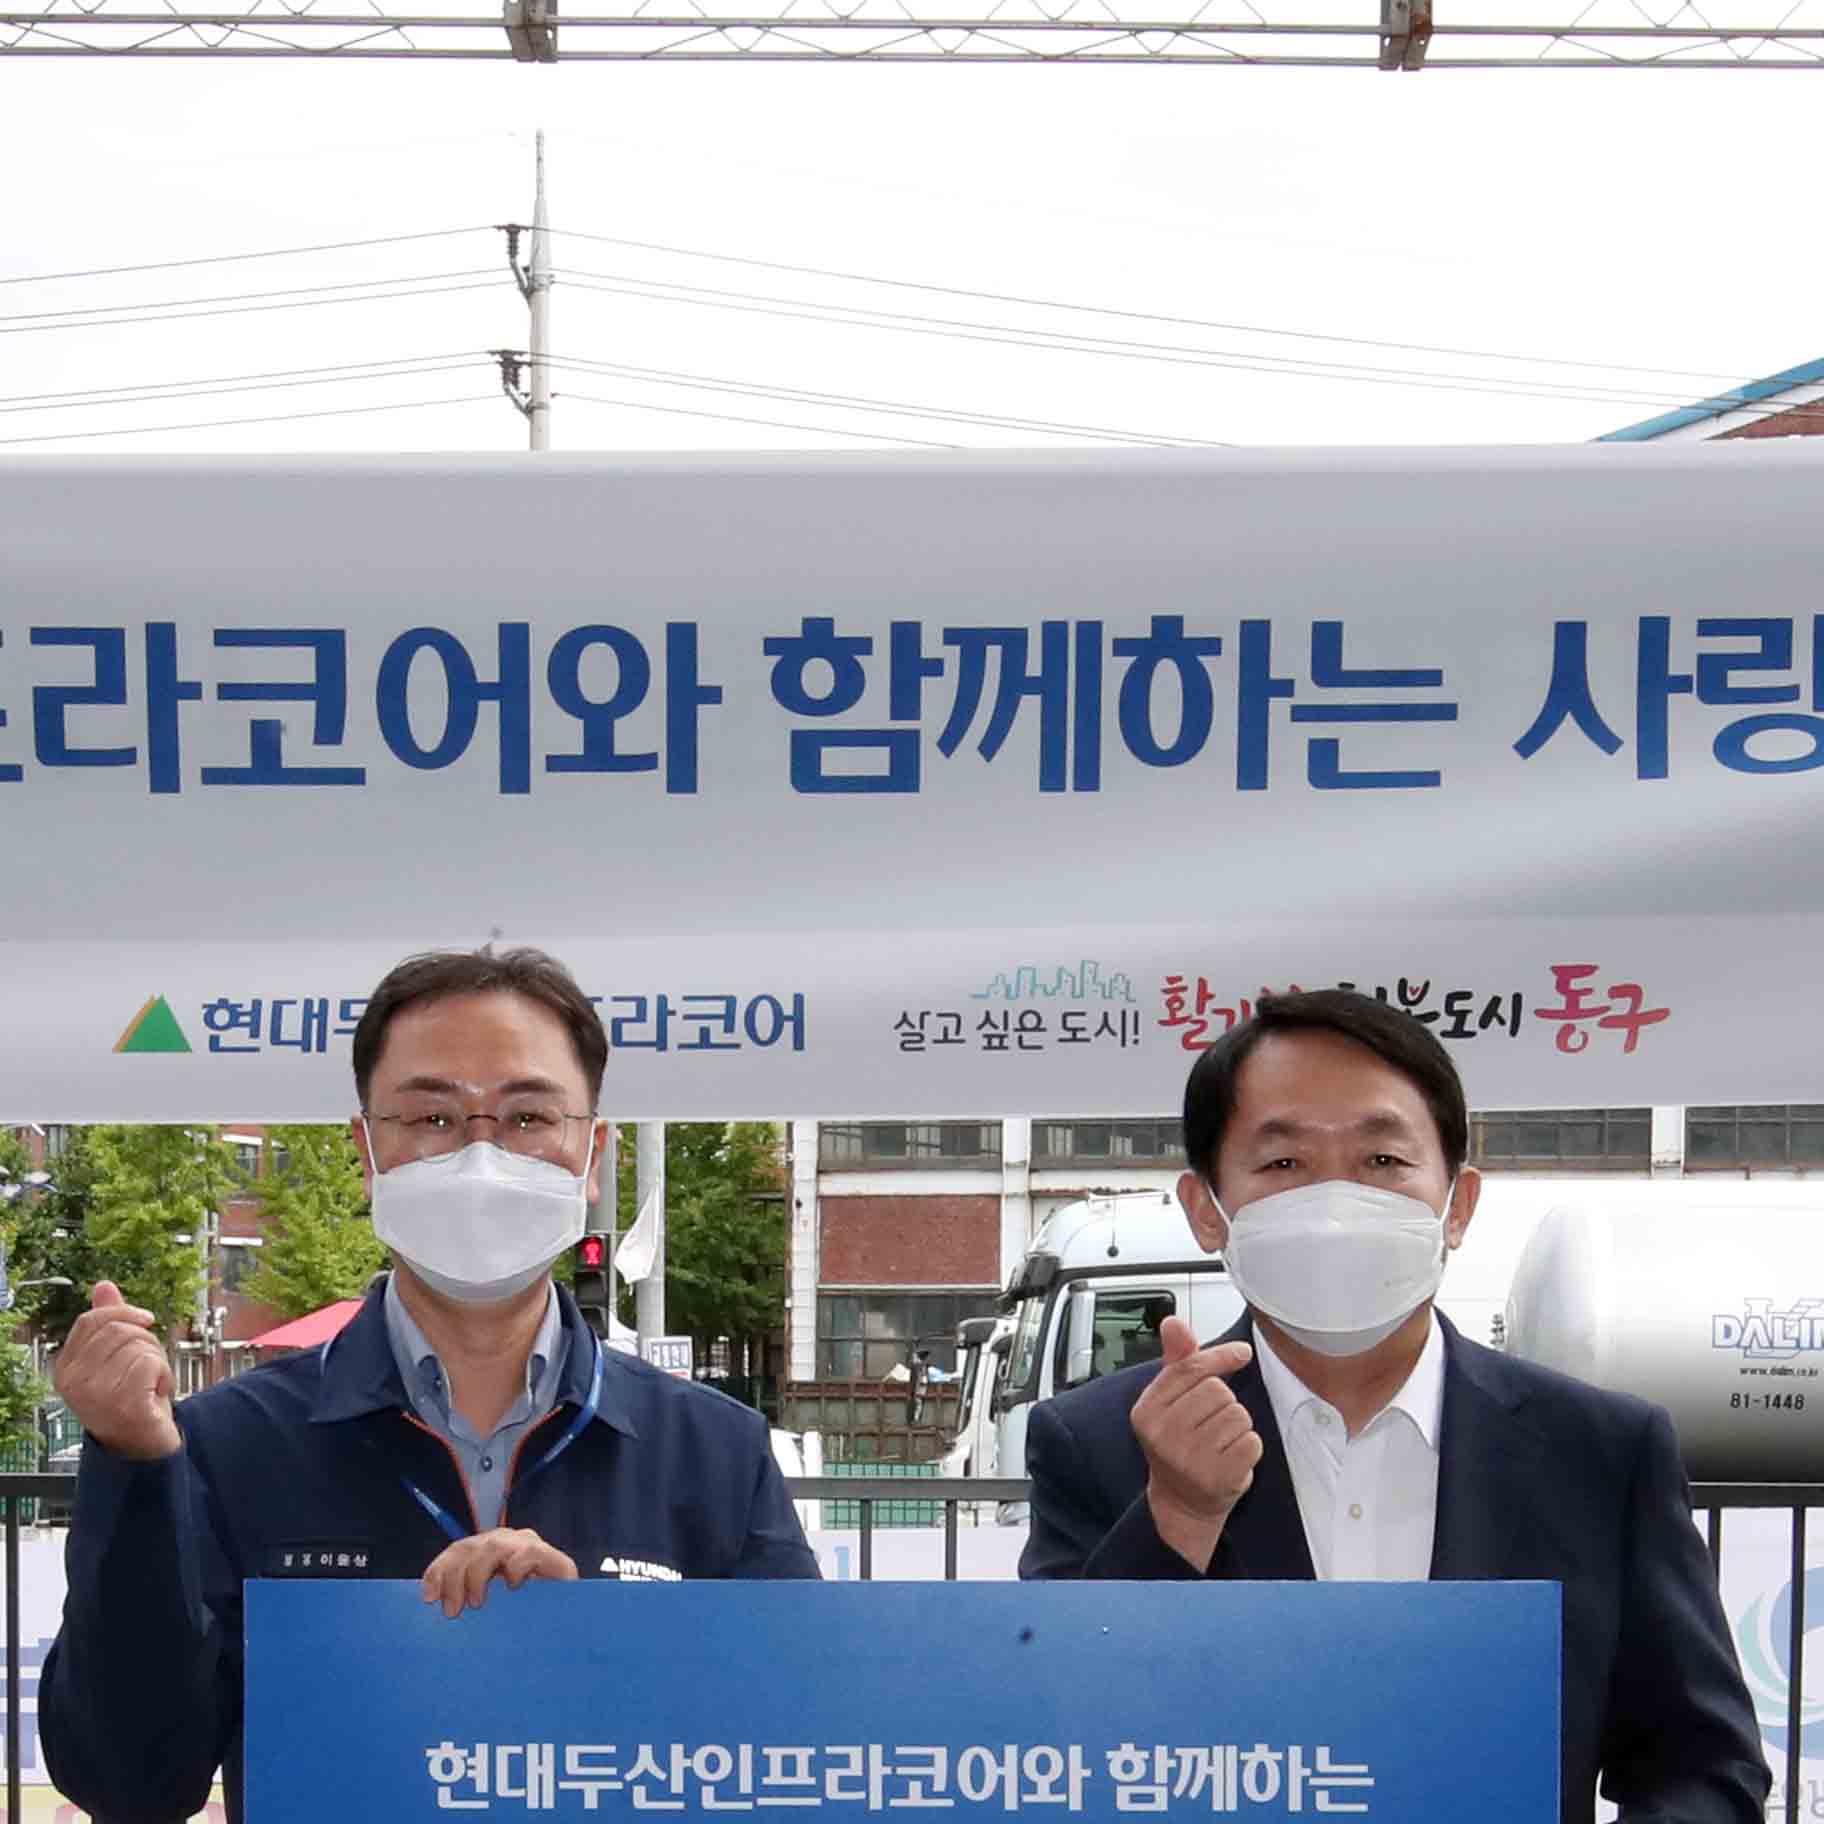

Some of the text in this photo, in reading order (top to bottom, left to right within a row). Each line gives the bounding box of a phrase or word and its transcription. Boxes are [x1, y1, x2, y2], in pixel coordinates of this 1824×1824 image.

[765, 614, 1458, 795] 함께하는
[201, 993, 806, 1053] 현대라코어
[893, 1007, 1140, 1052] 살고 싶은 도시!
[1534, 964, 1671, 1054] 동구
[426, 1741, 1374, 1812] 현대두산인프라코어와 함께하는
